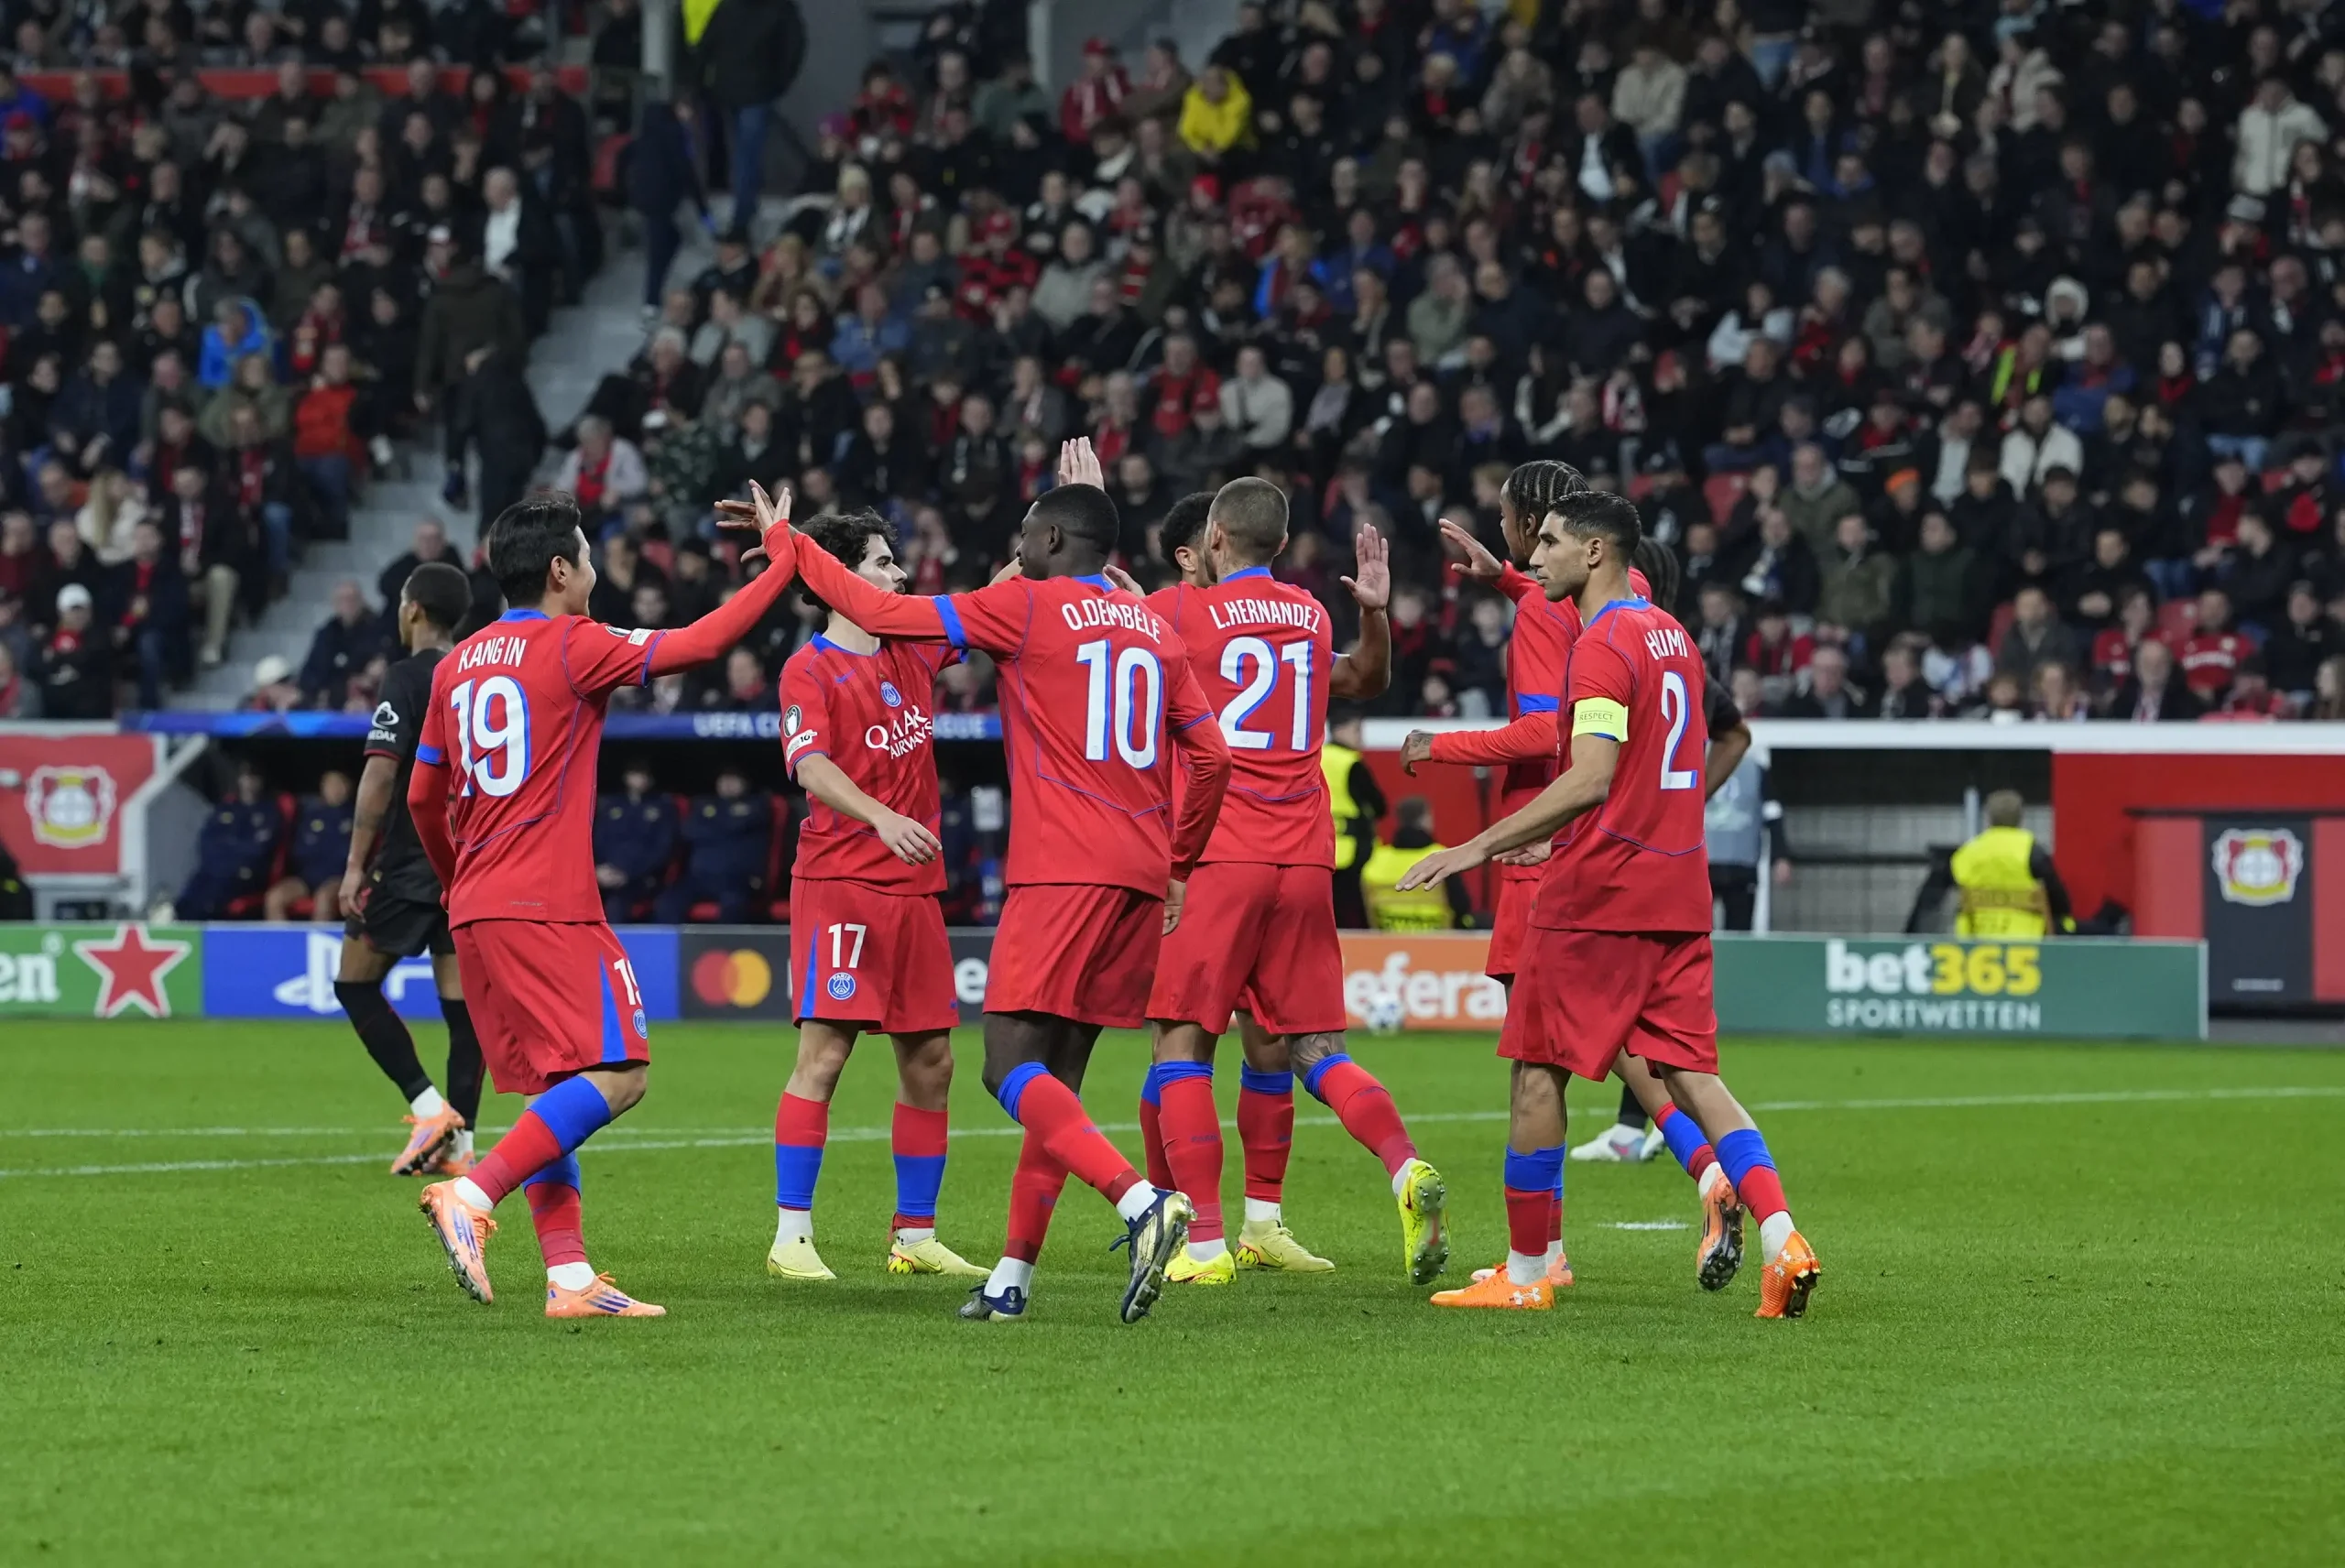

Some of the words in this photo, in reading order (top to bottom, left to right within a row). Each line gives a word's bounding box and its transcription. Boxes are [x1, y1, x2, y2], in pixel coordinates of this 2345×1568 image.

[1062, 598, 1161, 644] O.DEMBÉLÉ
[1208, 598, 1321, 635] L.HERNANDEZ
[1076, 639, 1162, 769] 10
[1218, 636, 1313, 751] 21
[1579, 713, 1613, 722] RESPECT
[451, 675, 531, 797] 19
[1661, 670, 1697, 789] 2
[828, 923, 867, 968] 17
[1826, 938, 2042, 996] bet365
[1826, 998, 2042, 1030] SPORTWETTEN
